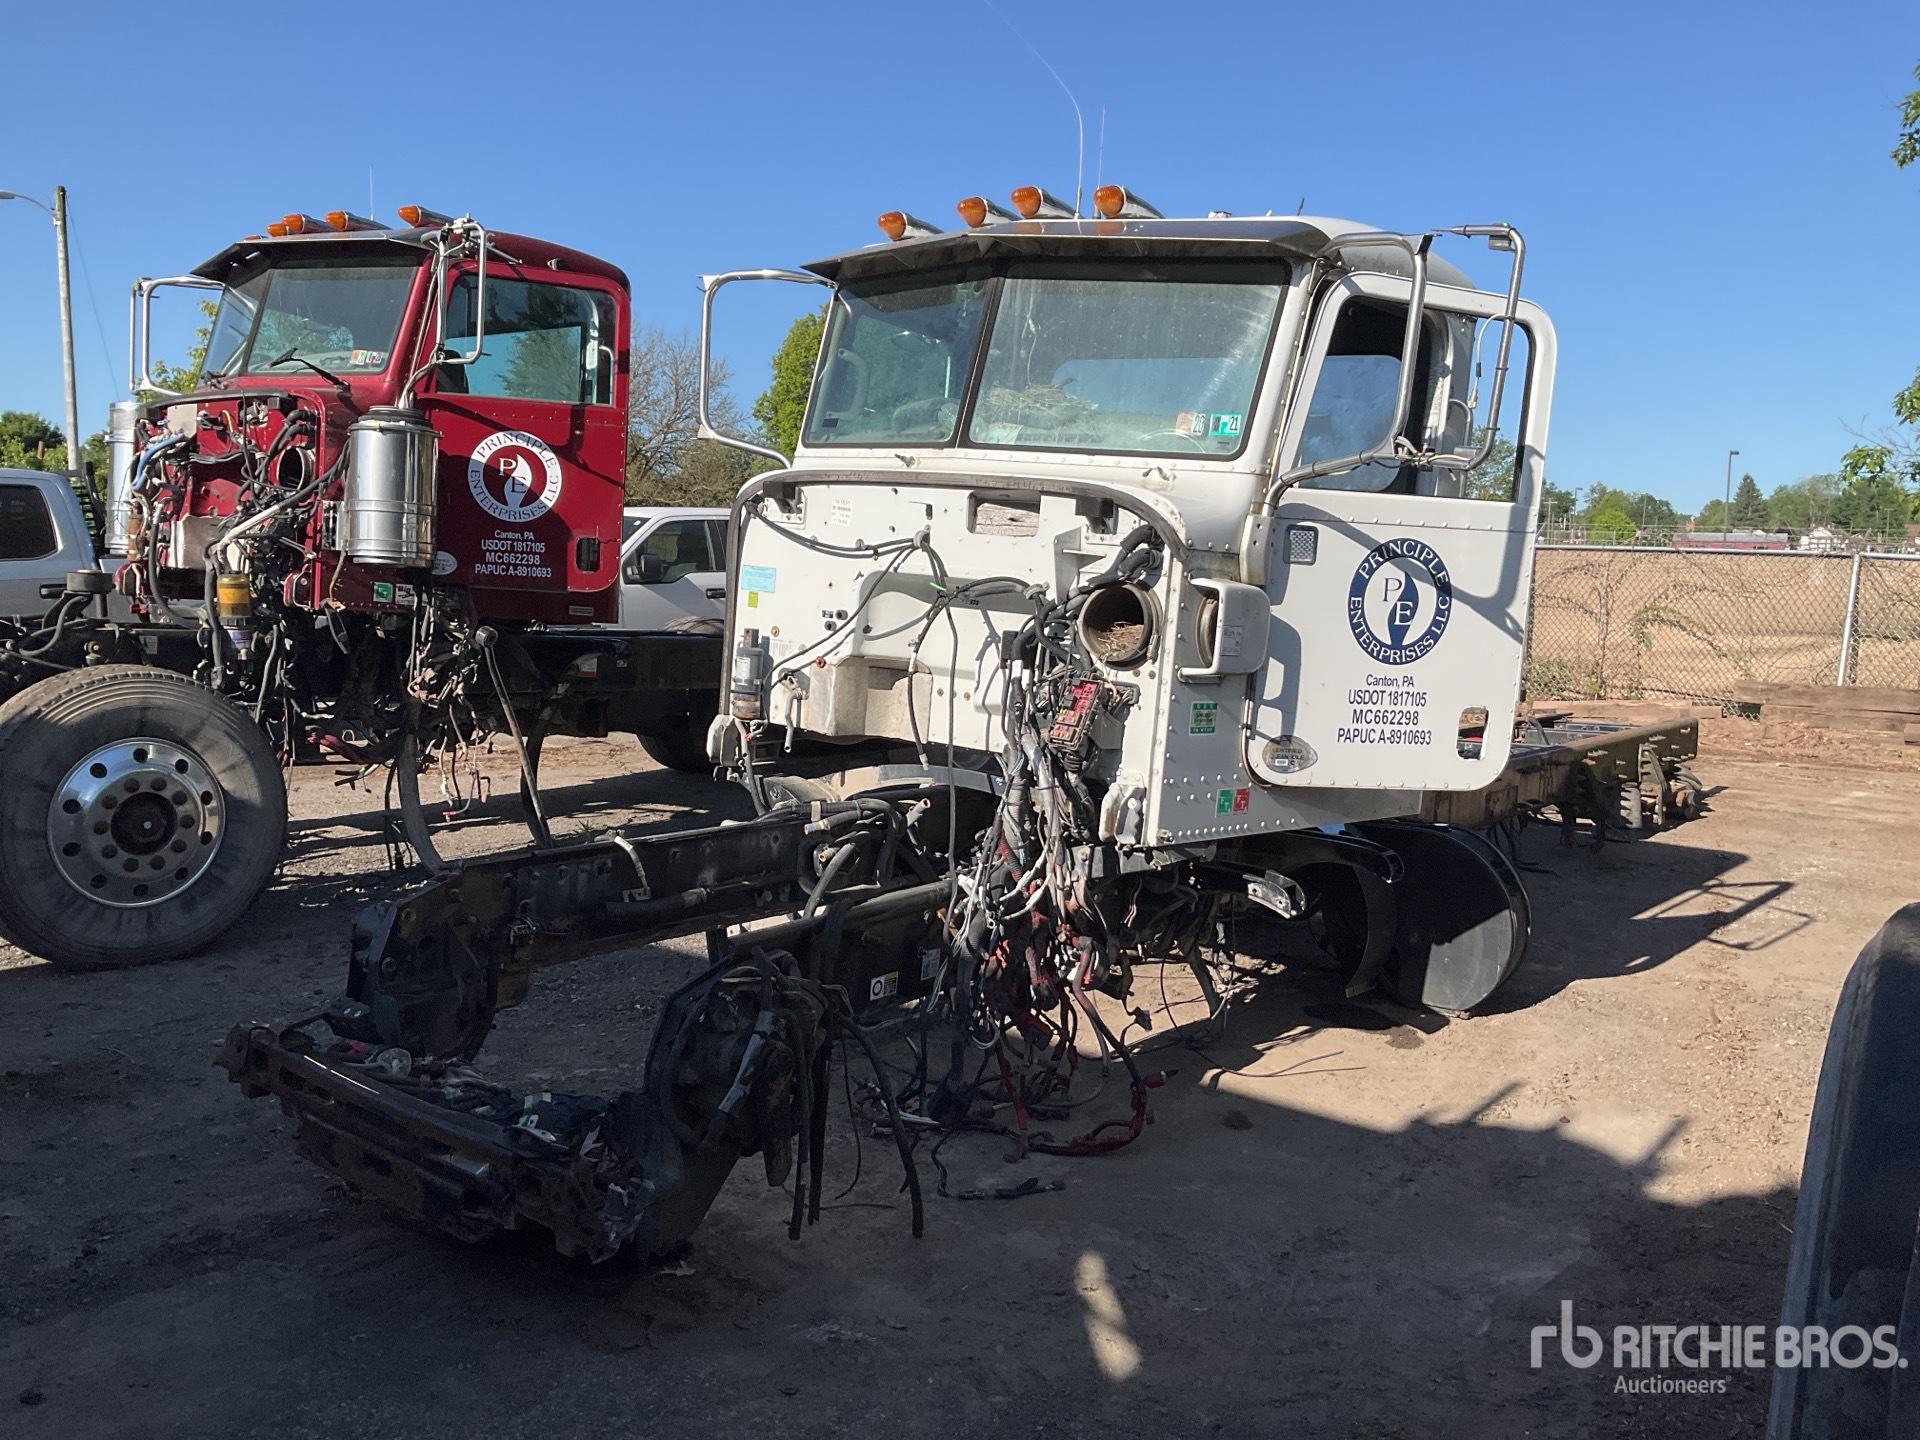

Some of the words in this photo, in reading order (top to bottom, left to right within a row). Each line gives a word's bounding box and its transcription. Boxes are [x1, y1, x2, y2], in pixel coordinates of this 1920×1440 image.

[1230, 416, 1239, 431] 21
[477, 432, 558, 469] PRINCIPLE
[499, 458, 516, 476] P
[511, 476, 527, 494] E
[470, 469, 547, 520] ENTERPRISES
[544, 475, 559, 503] LLC
[494, 530, 523, 540] Canton,
[523, 531, 535, 541] PA
[481, 539, 512, 551] USDOT
[513, 541, 545, 553] 1817105
[485, 552, 540, 565] MC662298
[1358, 540, 1449, 587] PRINCIPLE
[474, 563, 506, 576] PAPUC
[507, 566, 552, 578] A-8910693
[1382, 577, 1402, 602] P
[1394, 601, 1412, 626] E
[1351, 596, 1434, 663] ENTERPRISES
[1432, 596, 1450, 631] LLC
[1366, 674, 1400, 688] Canton,
[1402, 676, 1415, 688] PA
[1348, 689, 1386, 705] USDOT
[1387, 691, 1427, 707] 1817105
[1352, 709, 1419, 727] MC662298
[1337, 727, 1376, 744] PAPUC
[1378, 730, 1432, 746] A-8910693
